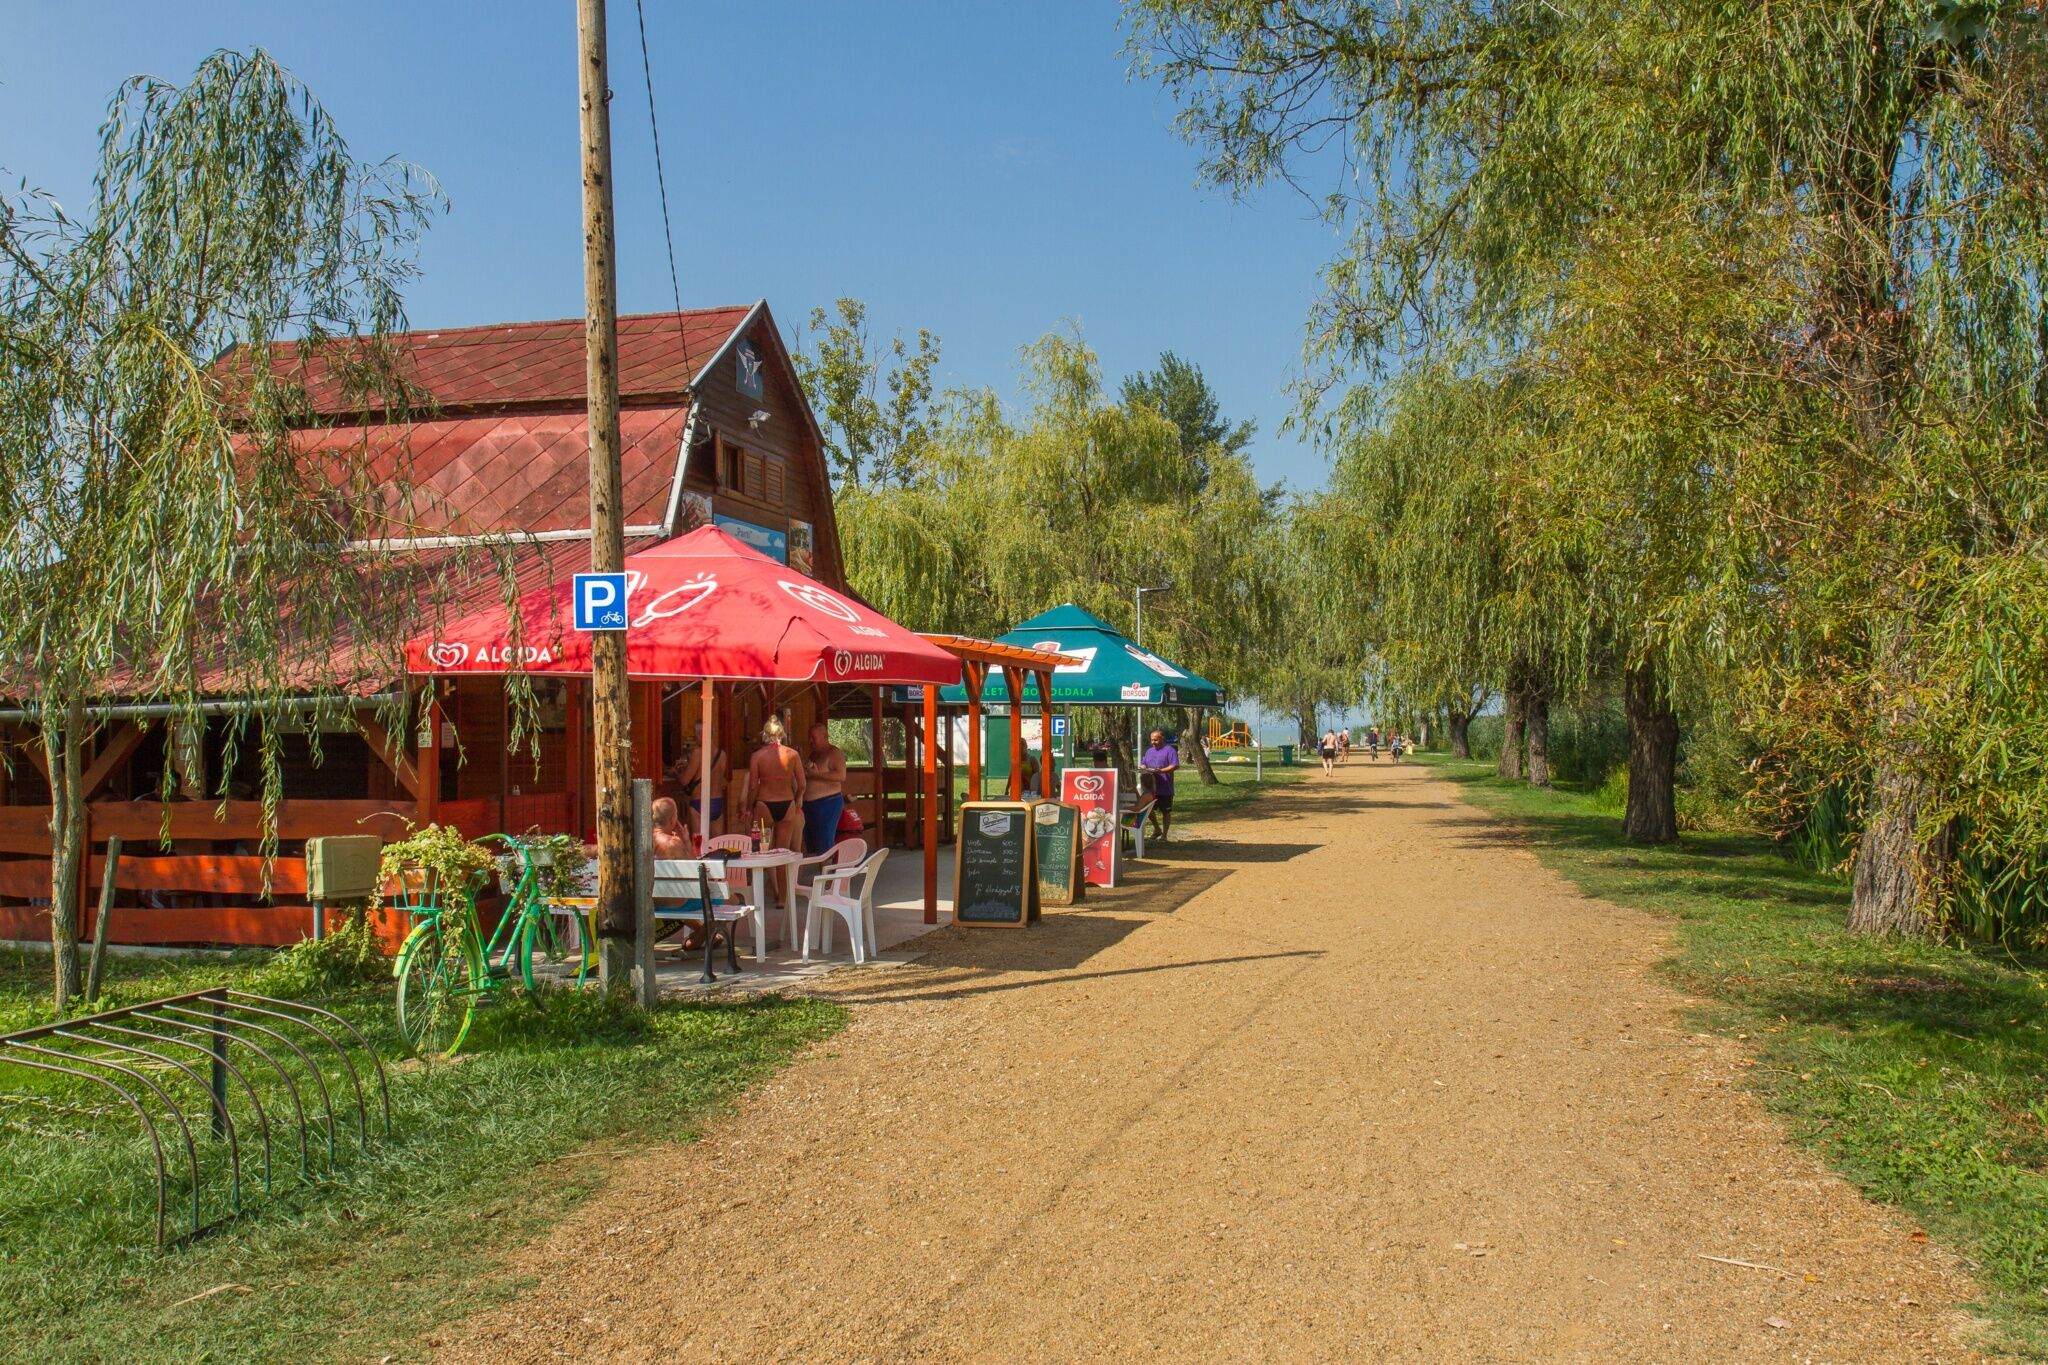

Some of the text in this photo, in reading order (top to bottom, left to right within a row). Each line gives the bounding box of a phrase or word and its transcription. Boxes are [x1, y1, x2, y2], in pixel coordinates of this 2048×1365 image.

[584, 580, 616, 624] P
[475, 646, 552, 663] ALGIDA
[854, 654, 884, 671] ALGIDA
[1055, 719, 1065, 734] P
[1073, 793, 1104, 801] ALGIDA
